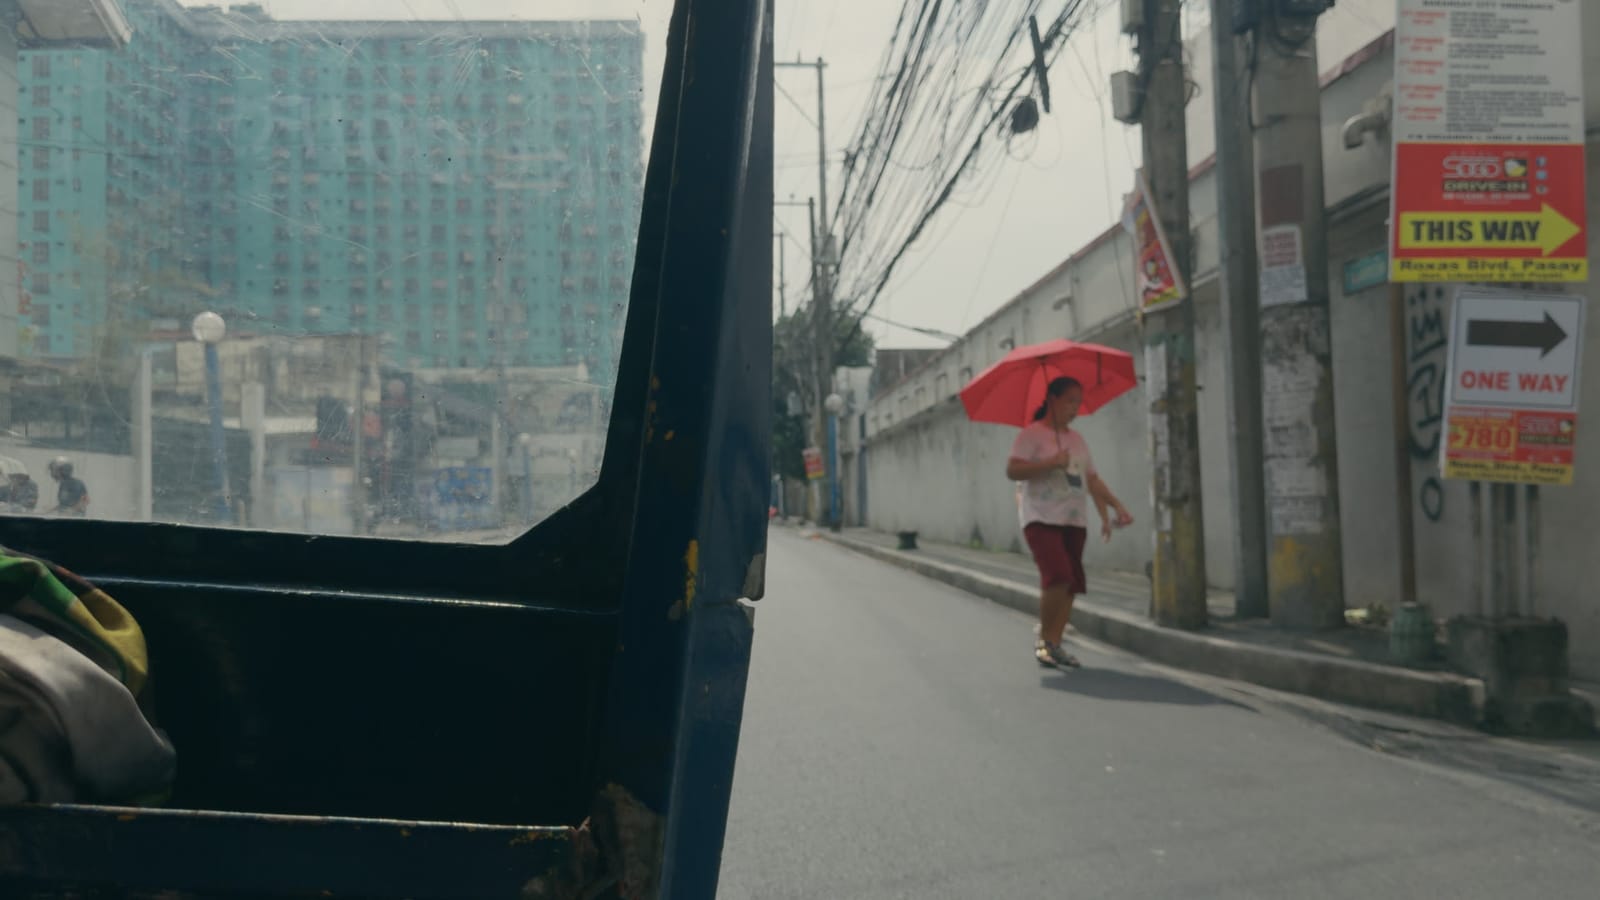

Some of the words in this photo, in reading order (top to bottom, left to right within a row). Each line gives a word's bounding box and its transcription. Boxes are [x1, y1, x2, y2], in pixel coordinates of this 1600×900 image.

[1411, 220, 1474, 241] THIS
[1480, 220, 1541, 242] WAY
[1400, 260, 1459, 271] Roxas
[1522, 260, 1582, 273] Pasay
[1460, 370, 1511, 391] ONE
[1517, 373, 1569, 393] WAY
